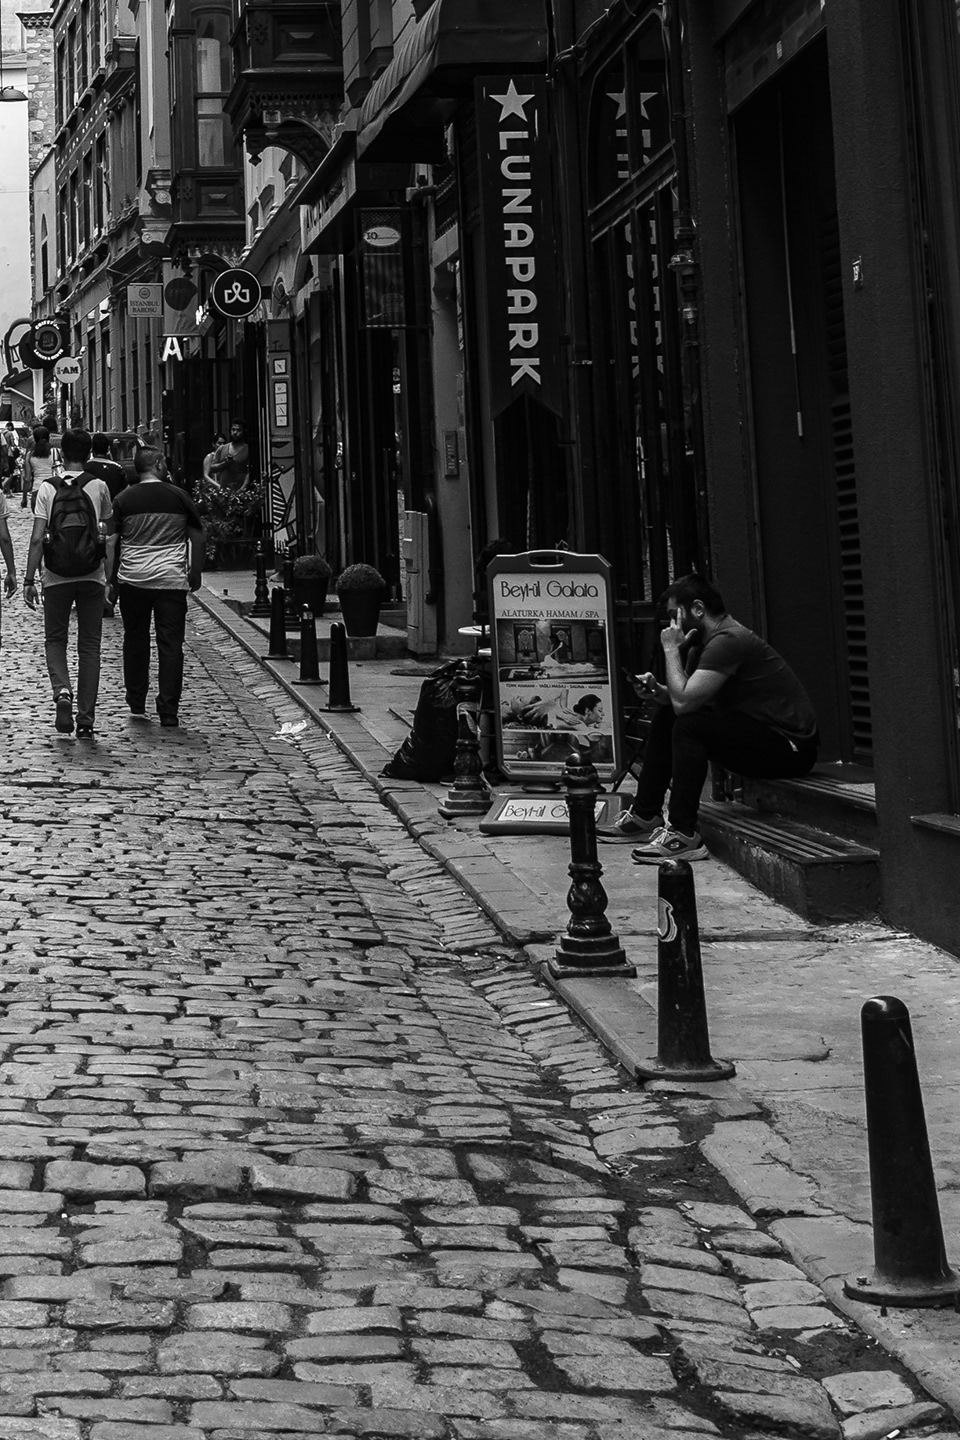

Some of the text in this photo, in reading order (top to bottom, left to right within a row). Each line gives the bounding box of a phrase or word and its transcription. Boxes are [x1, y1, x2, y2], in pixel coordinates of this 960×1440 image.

[498, 130, 542, 388] LUNAPARK
[546, 580, 599, 598] Galata
[501, 609, 544, 618] ALATURKA
[546, 610, 578, 618] HAMAM
[585, 611, 600, 619] SPA
